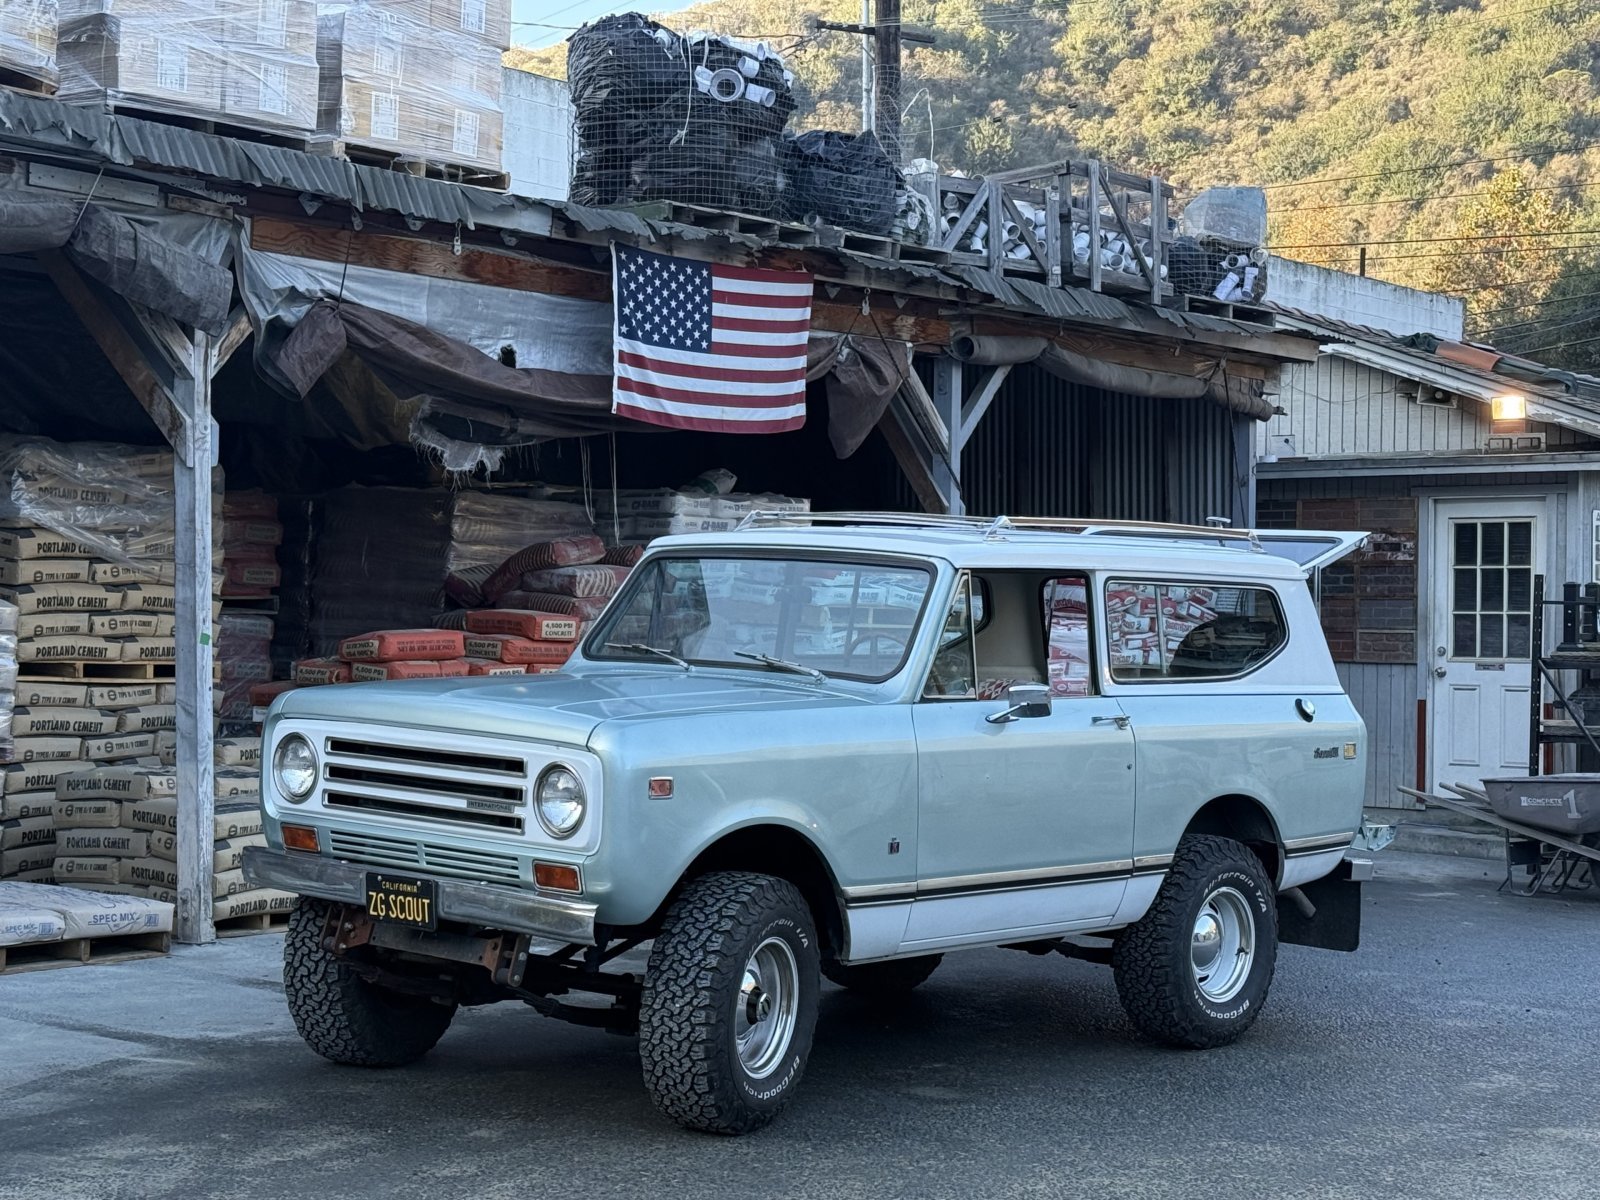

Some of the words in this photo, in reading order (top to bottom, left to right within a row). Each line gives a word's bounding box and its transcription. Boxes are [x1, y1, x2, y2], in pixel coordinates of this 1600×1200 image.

[37, 542, 76, 554] PORTLAND
[144, 543, 175, 554] PORTLA
[36, 596, 75, 608] PORTLAND
[77, 596, 108, 608] CEMENT
[65, 625, 80, 633] CEMENT
[36, 645, 76, 658] PORTLAND
[77, 645, 108, 658] CEMENT
[140, 646, 176, 657] PORTLAND
[468, 649, 497, 657] CONCRETE
[373, 668, 383, 676] PSI
[42, 696, 51, 704] TYPE
[62, 696, 77, 704] CEMENT
[30, 719, 71, 731] PORTLAND
[73, 721, 104, 733] CEMENT
[240, 748, 260, 760] PORTL
[25, 774, 57, 787] PORTLA
[66, 779, 102, 791] PORTLAND
[103, 778, 131, 791] CEMENT
[132, 809, 166, 826] PORTLAND
[22, 828, 57, 843] PORTLAN
[240, 826, 249, 834] TYPE
[66, 837, 100, 849] PORTLAND
[103, 837, 130, 850] CEMENT
[131, 866, 165, 882] PORTLAND
[382, 881, 418, 893] CALIFORNIA
[229, 900, 268, 917] PORTLAND
[368, 891, 386, 916] ZG
[389, 894, 430, 923] SCOUT
[93, 914, 118, 924] SPEC
[119, 912, 135, 921] MIX
[1193, 990, 1250, 1019] BFGoodrich
[743, 1055, 800, 1100] BFGoodrich
